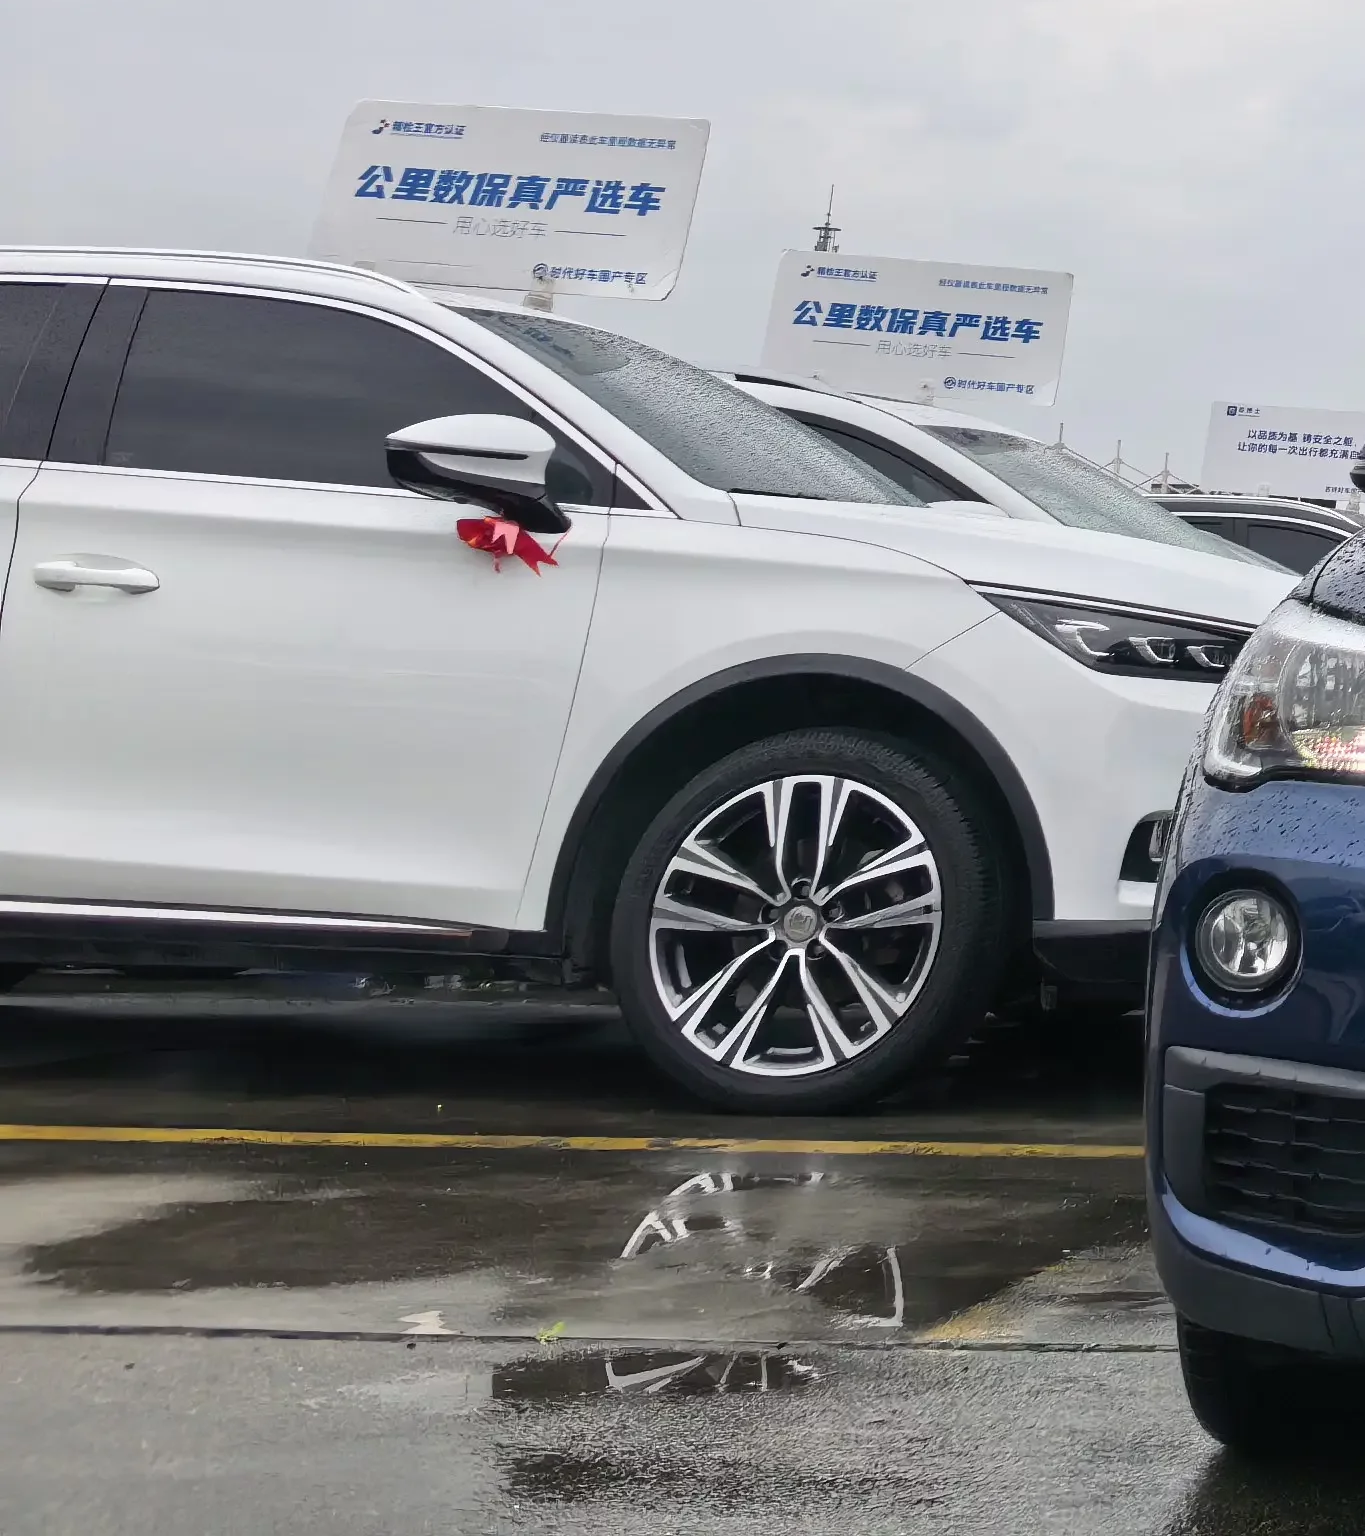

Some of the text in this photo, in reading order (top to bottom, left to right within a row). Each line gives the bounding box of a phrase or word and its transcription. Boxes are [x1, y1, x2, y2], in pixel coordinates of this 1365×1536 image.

[355, 164, 666, 217] 公里数保真严选车
[452, 215, 548, 238] 用心选好车
[792, 299, 1044, 344] 公里数保真严选车
[875, 339, 952, 358] 用心选好车
[1247, 429, 1298, 443] 以品质为基
